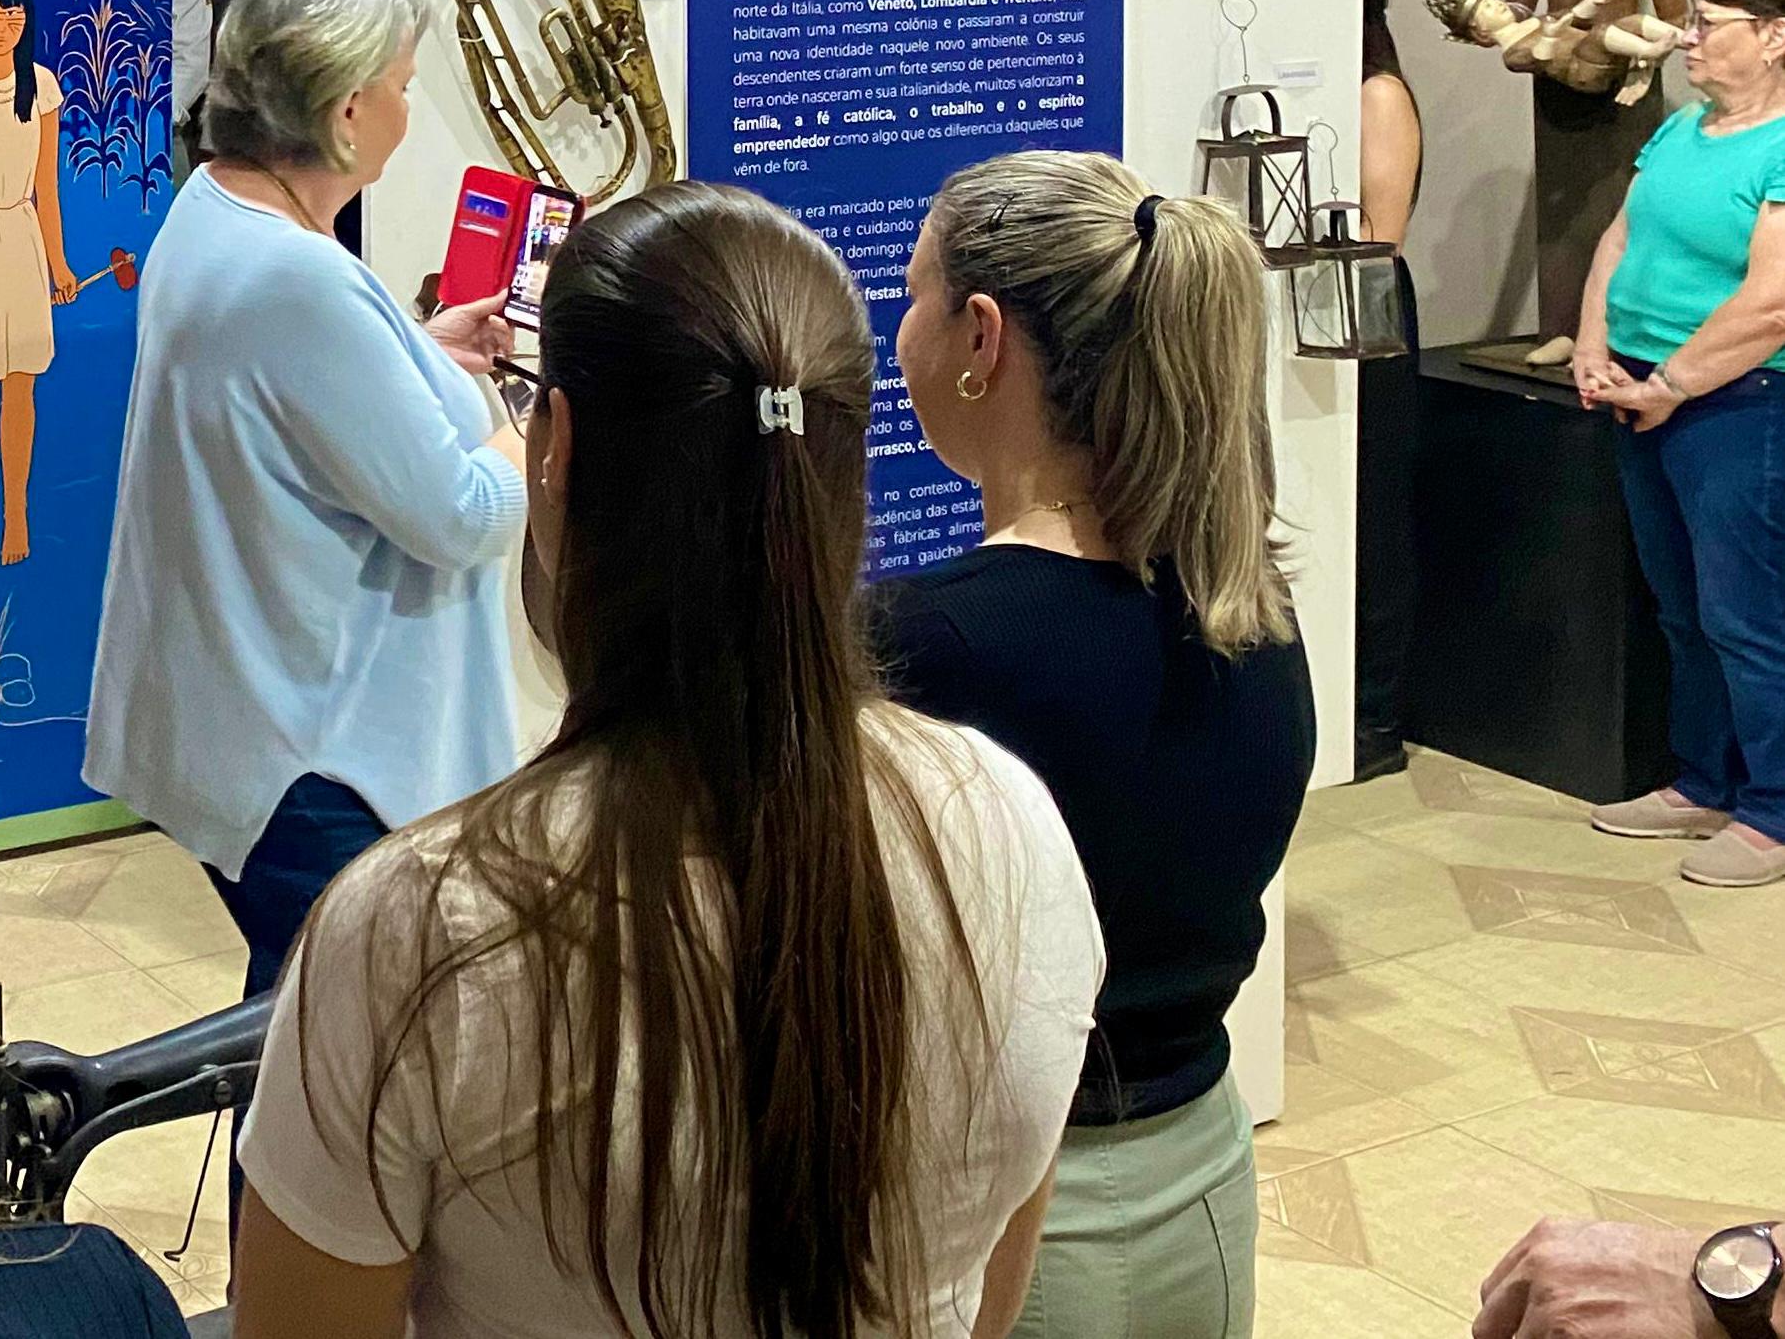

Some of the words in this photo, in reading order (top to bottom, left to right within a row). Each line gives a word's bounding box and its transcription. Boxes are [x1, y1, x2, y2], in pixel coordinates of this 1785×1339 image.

[733, 5, 767, 17] norte
[770, 2, 787, 16] da
[792, 1, 823, 15] Itália,
[827, 1, 863, 12] como
[733, 26, 800, 40] habitavam
[806, 24, 835, 36] uma
[841, 21, 888, 33] mesma
[894, 17, 937, 31] colônia
[943, 18, 951, 28] e
[957, 14, 1014, 30] passaram
[1019, 13, 1027, 24] a
[1032, 11, 1084, 23] construir
[733, 51, 762, 63] uma
[769, 49, 799, 60] nova
[806, 42, 873, 59] identidade
[880, 39, 929, 55] naquele
[935, 39, 965, 50] novo
[1036, 31, 1052, 45] Os
[1057, 32, 1084, 43] seus
[733, 69, 821, 86] descendentes
[823, 66, 871, 79] criaram
[874, 65, 896, 76] um
[899, 61, 927, 75] forte
[930, 60, 965, 73] senso
[968, 57, 984, 70] de
[987, 53, 1074, 71] pertencimento
[1076, 51, 1084, 64] à
[733, 96, 763, 108] terra
[766, 91, 798, 106] onde
[801, 89, 862, 103] nasceram
[864, 88, 873, 99] e
[875, 87, 897, 98] sua
[900, 80, 972, 96] italianidade,
[974, 77, 1016, 91] muitos
[1018, 75, 1074, 88] valorizam
[1076, 74, 1084, 85] a
[733, 115, 781, 131] família,
[794, 115, 803, 126] a
[816, 110, 829, 124] fé
[843, 106, 896, 122] católica,
[909, 107, 918, 118] o
[931, 100, 983, 116] trabalho
[996, 101, 1004, 111] e
[1017, 99, 1026, 110] o
[1038, 92, 1084, 110] espírito
[733, 133, 830, 155] empreendedor
[833, 133, 869, 145] como
[872, 129, 898, 145] algo
[900, 128, 924, 141] que
[927, 127, 941, 138] os
[944, 123, 1002, 137] diferencia
[1005, 117, 1058, 133] daqueles
[1060, 117, 1083, 129] que
[733, 162, 761, 176] vêm
[764, 160, 780, 173] de
[783, 157, 809, 171] fora.
[806, 206, 825, 218] era
[830, 198, 884, 216] marcado
[888, 196, 914, 212] pelo
[843, 226, 851, 237] e
[856, 217, 914, 236] cuidando
[847, 243, 904, 258] domingo
[865, 286, 903, 301] festas
[899, 420, 913, 431] os
[884, 490, 900, 502] no
[909, 481, 962, 499] contexto
[926, 504, 948, 518] das
[894, 525, 941, 545] fábricas
[880, 554, 910, 569] serra
[918, 544, 963, 566] gaúcha
